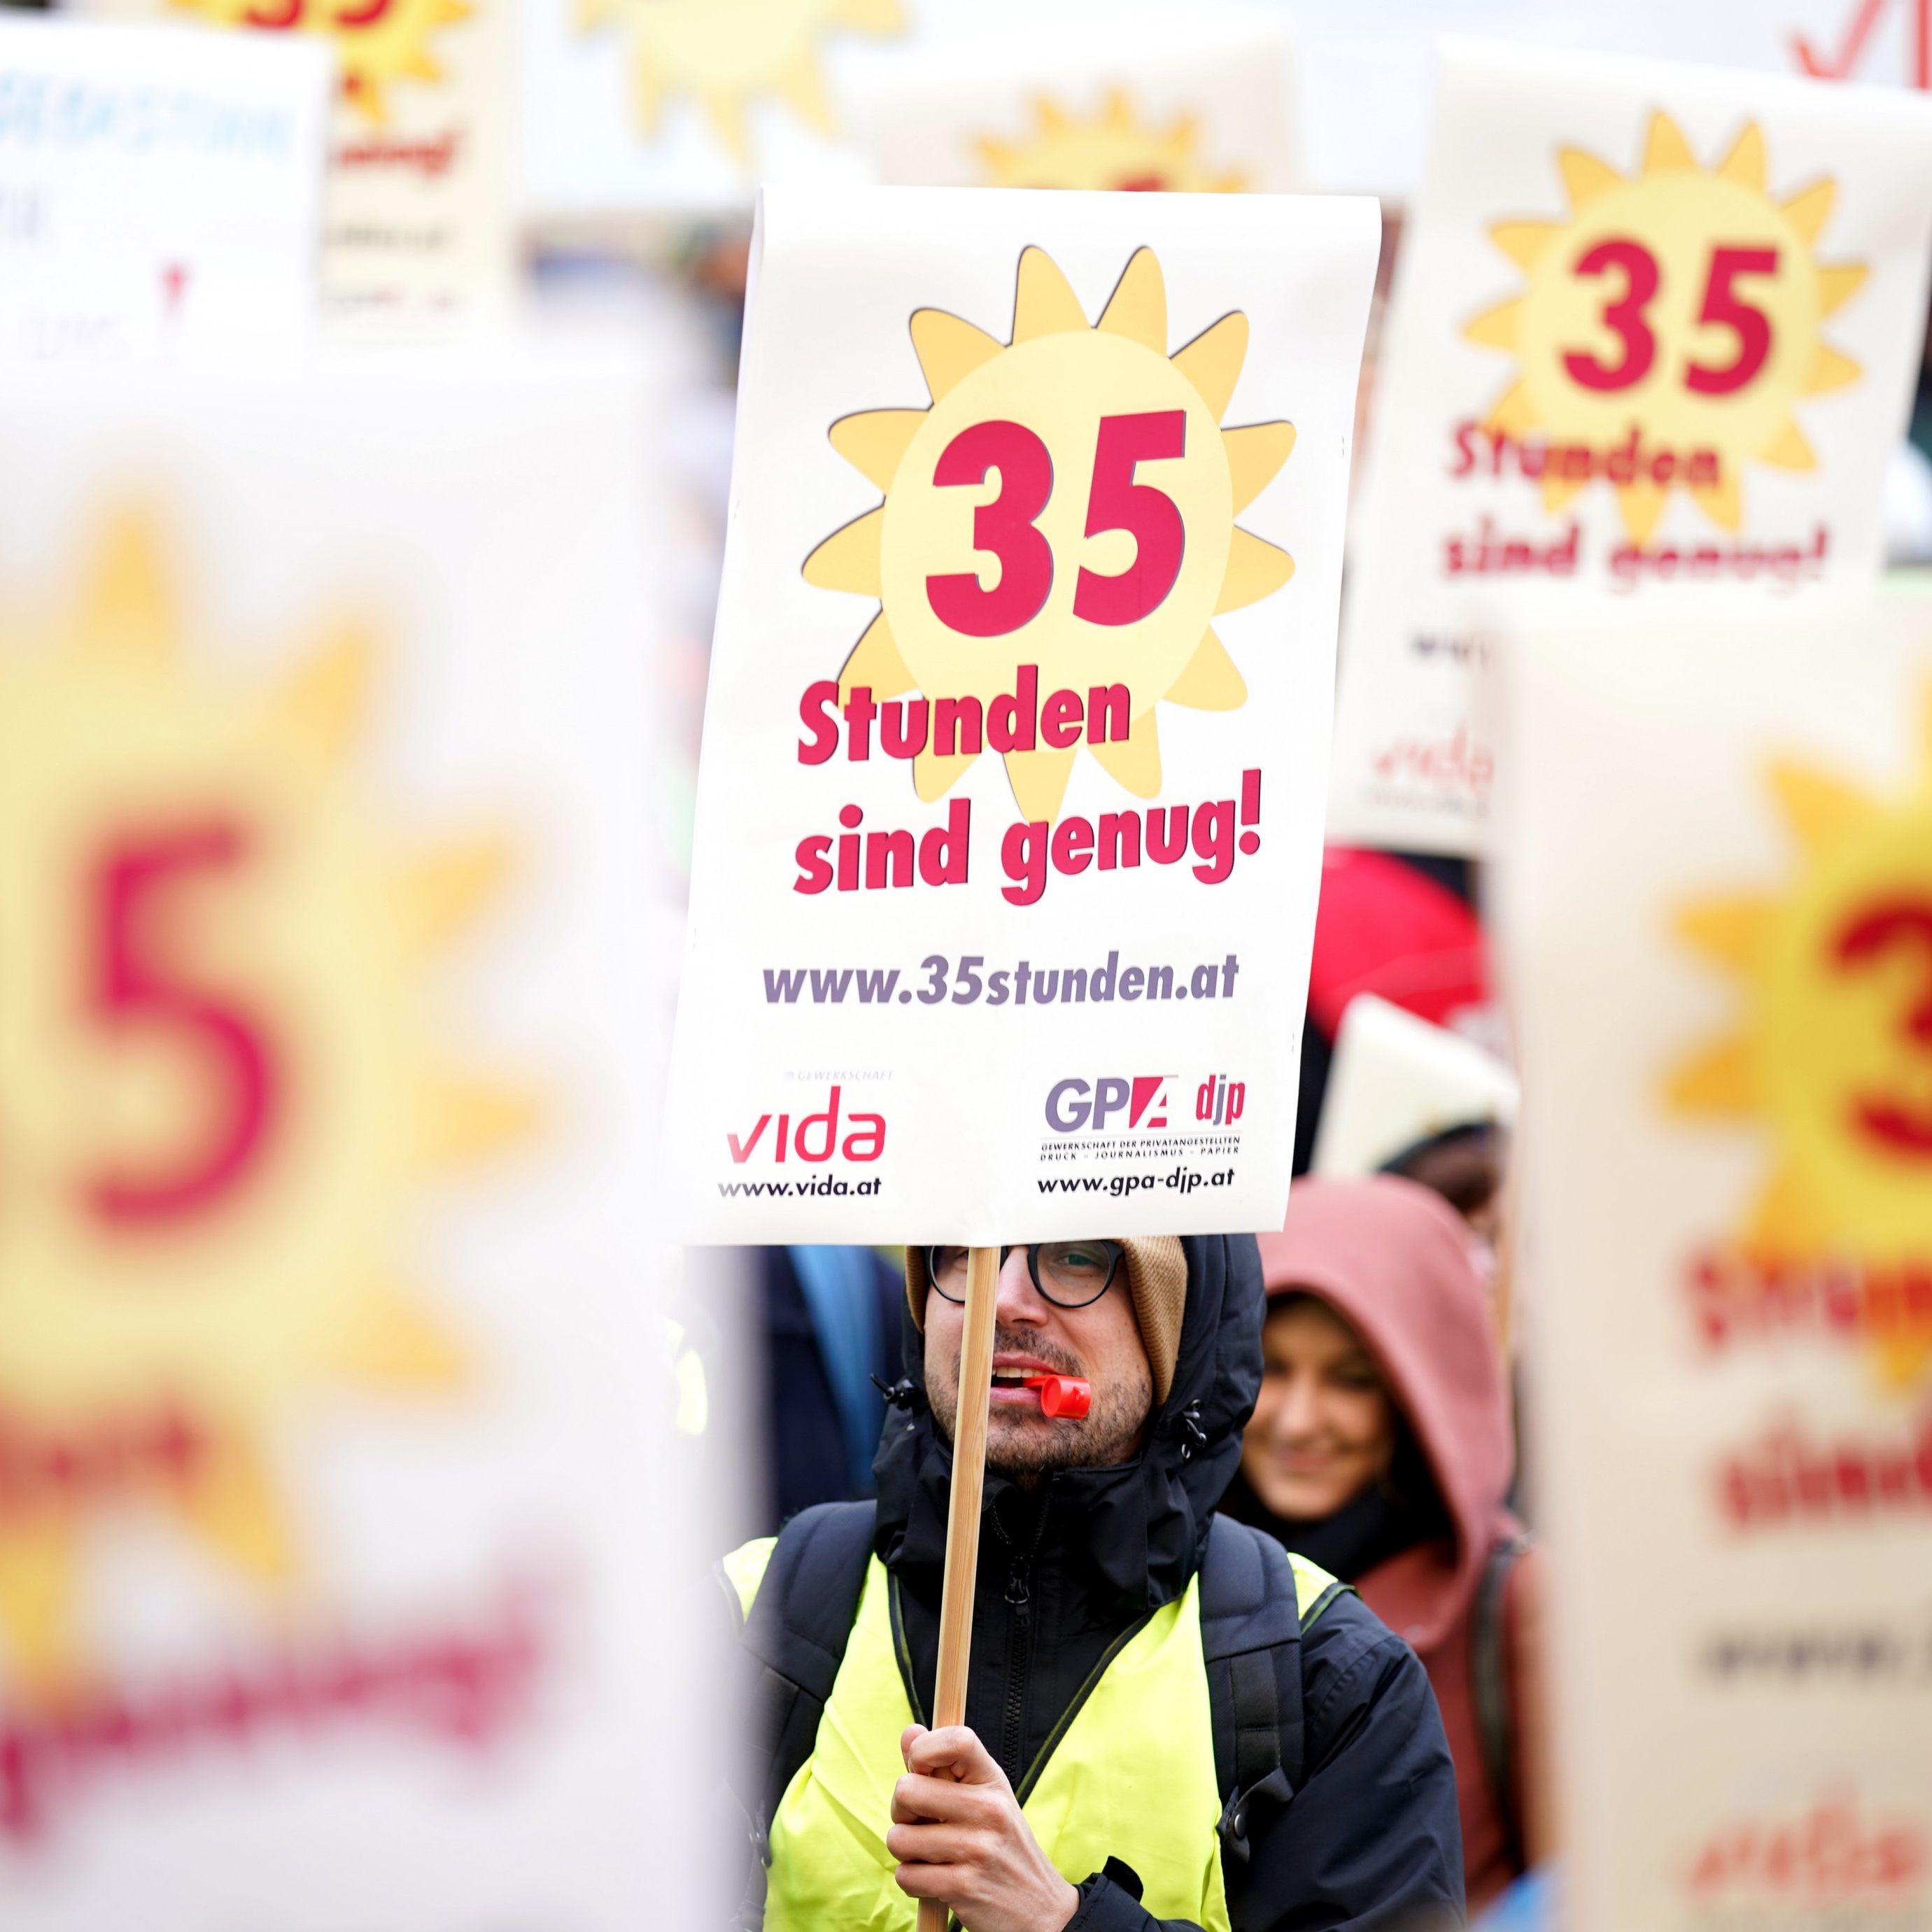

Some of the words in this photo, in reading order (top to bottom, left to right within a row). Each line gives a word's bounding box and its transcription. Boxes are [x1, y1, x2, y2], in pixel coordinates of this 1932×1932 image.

[1560, 237, 1780, 397] 35
[1447, 420, 1723, 491] Stunden
[926, 409, 1186, 638] 35
[797, 663, 1131, 766] Stunden
[793, 798, 971, 895] sind
[1001, 768, 1262, 907] genug!
[762, 950, 1240, 1006] www.35stunden.at
[798, 1070, 894, 1082] GEWERKSCHAFT
[1195, 1073, 1246, 1126] djp
[727, 1085, 887, 1164] vida
[1041, 1141, 1116, 1152] GEWERKSCHAFT
[1120, 1139, 1136, 1148] DER
[1140, 1136, 1240, 1148] PRIVATANGESTELLTEN
[1037, 1165, 1236, 1198] www.gpa-djp.at
[1040, 1152, 1077, 1162] DRUCK
[1094, 1148, 1183, 1159] JOURNALISMUS
[1201, 1145, 1239, 1155] PAPIER
[718, 1173, 882, 1198] www.vida.at
